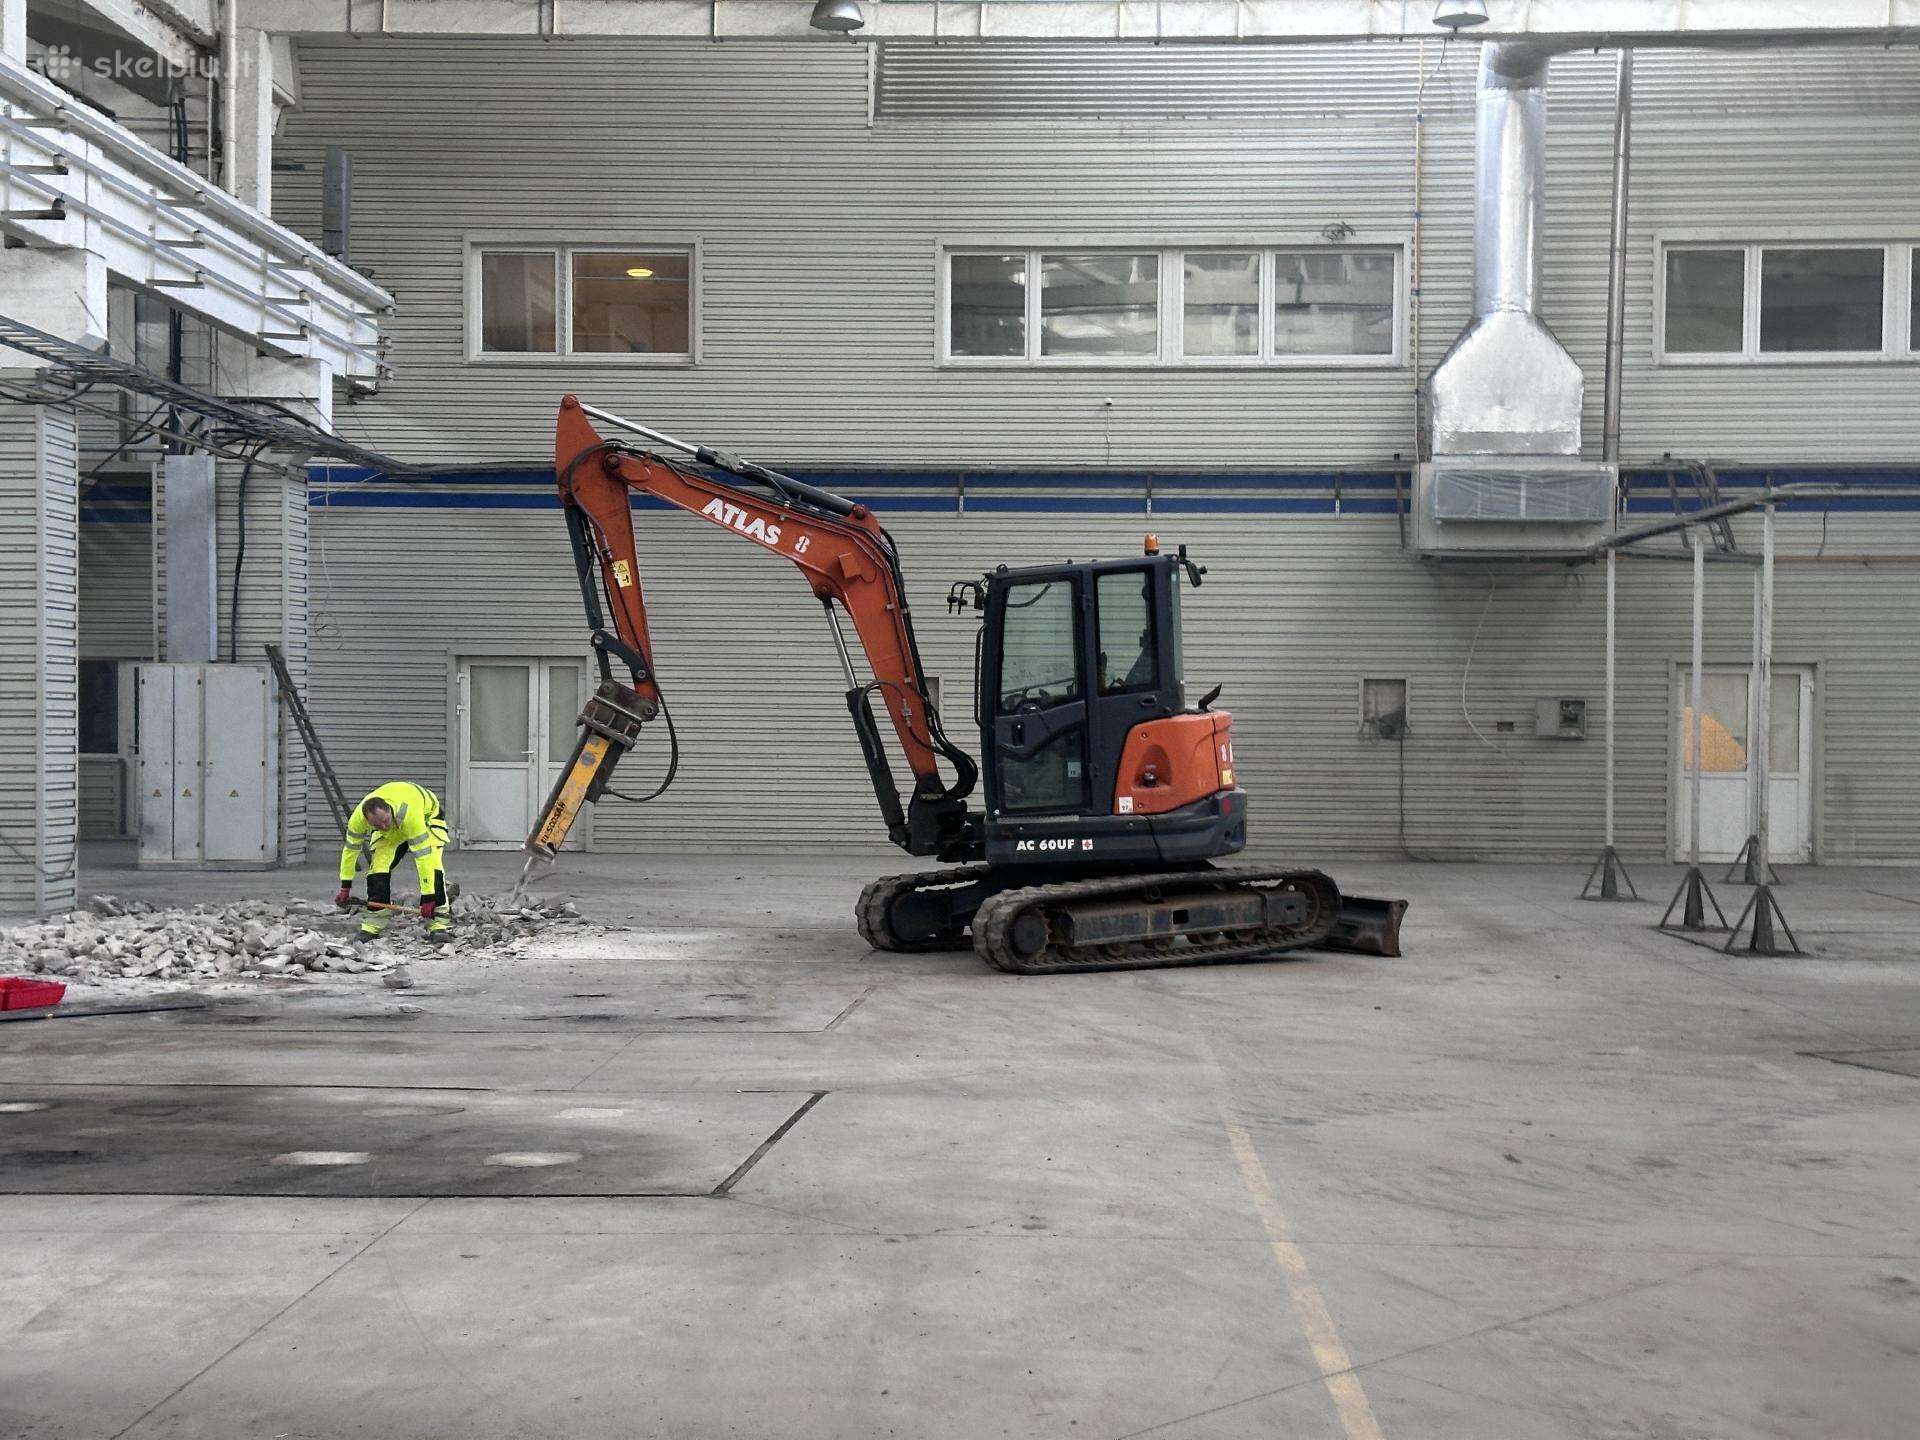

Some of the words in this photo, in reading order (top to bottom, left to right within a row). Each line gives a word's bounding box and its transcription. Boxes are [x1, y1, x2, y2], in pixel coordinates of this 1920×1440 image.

[701, 497, 782, 545] ATLAS
[794, 535, 811, 553] 8
[1016, 840, 1035, 851] AC
[1039, 839, 1075, 851] 60UF
